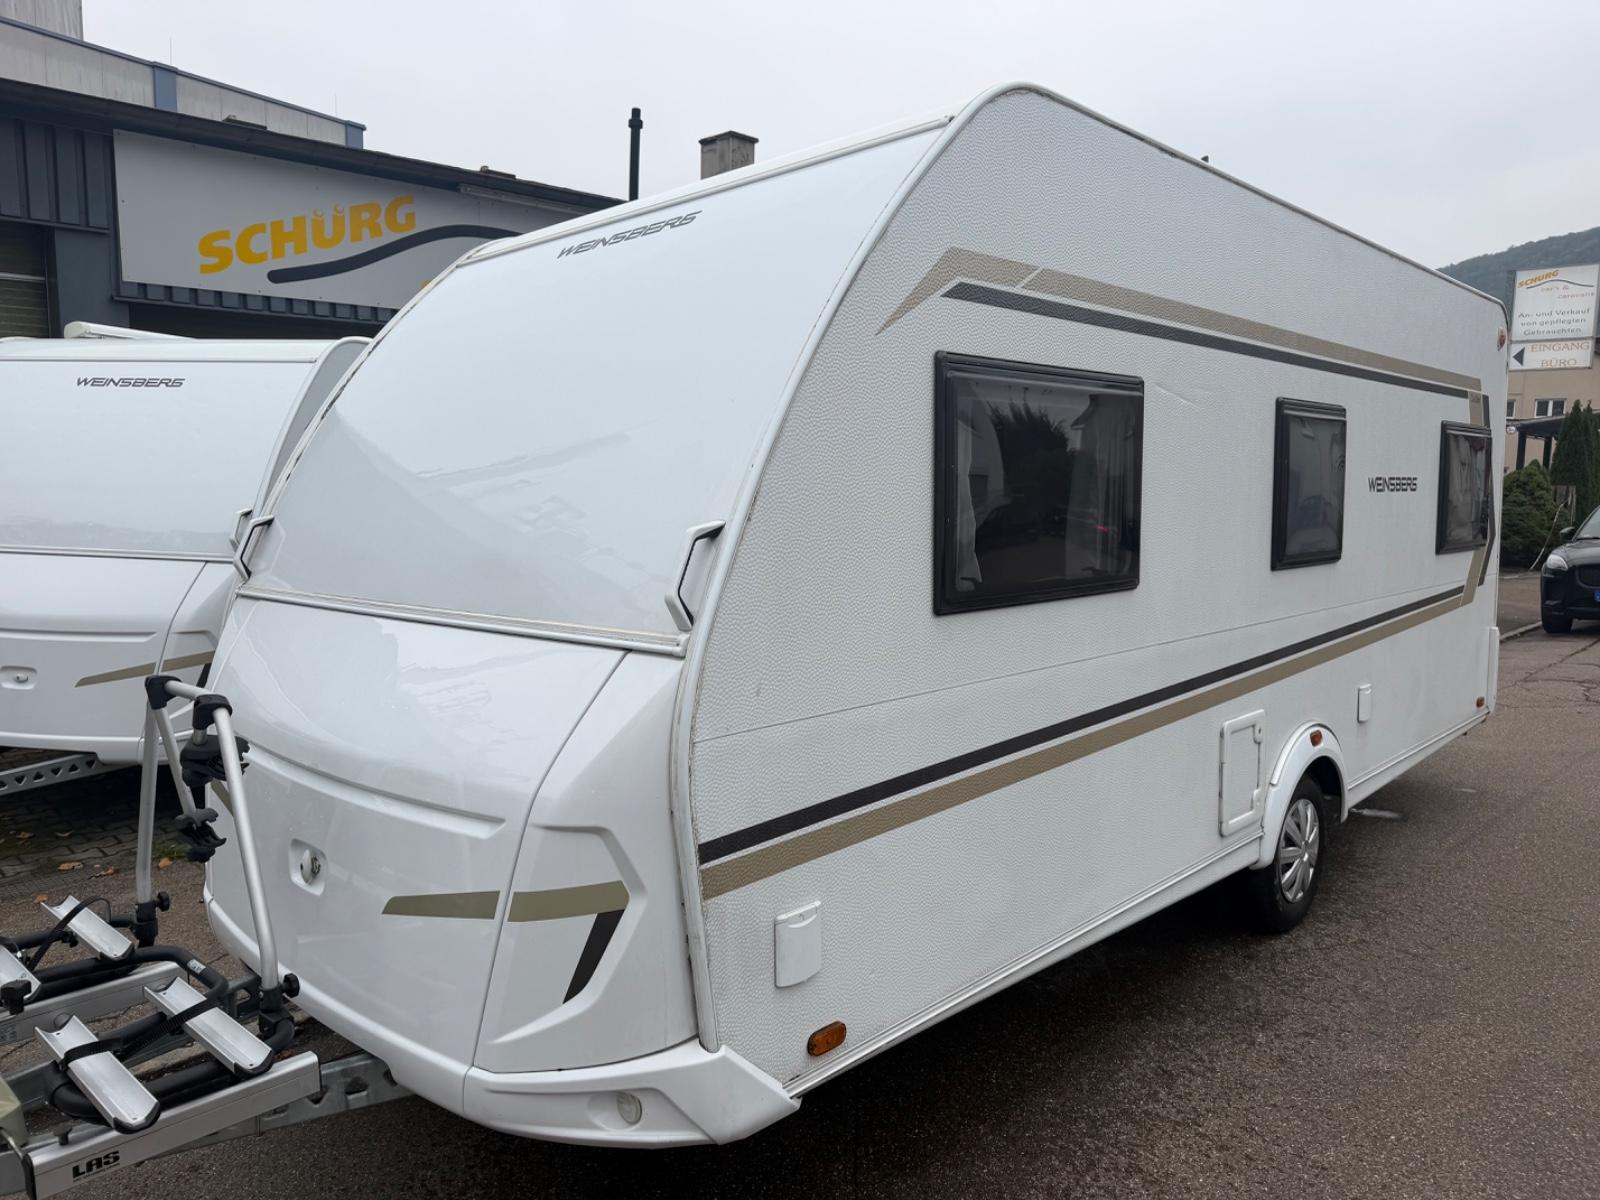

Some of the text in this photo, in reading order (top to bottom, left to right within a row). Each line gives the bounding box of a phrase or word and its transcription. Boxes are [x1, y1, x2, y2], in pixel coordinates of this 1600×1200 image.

[198, 195, 417, 275] SCHÜRG
[557, 210, 703, 259] WEINSBERG
[1535, 309, 1553, 318] und
[1554, 307, 1590, 316] Verkauf
[1521, 317, 1586, 328] von gepflegten
[1523, 327, 1582, 336] Gebrauchten
[1530, 341, 1590, 353] EINGANG
[1541, 357, 1577, 368] BÜRO
[76, 377, 185, 388] WEINSBERG
[1367, 476, 1418, 493] WEINSBERG
[72, 1150, 120, 1178] LAS
